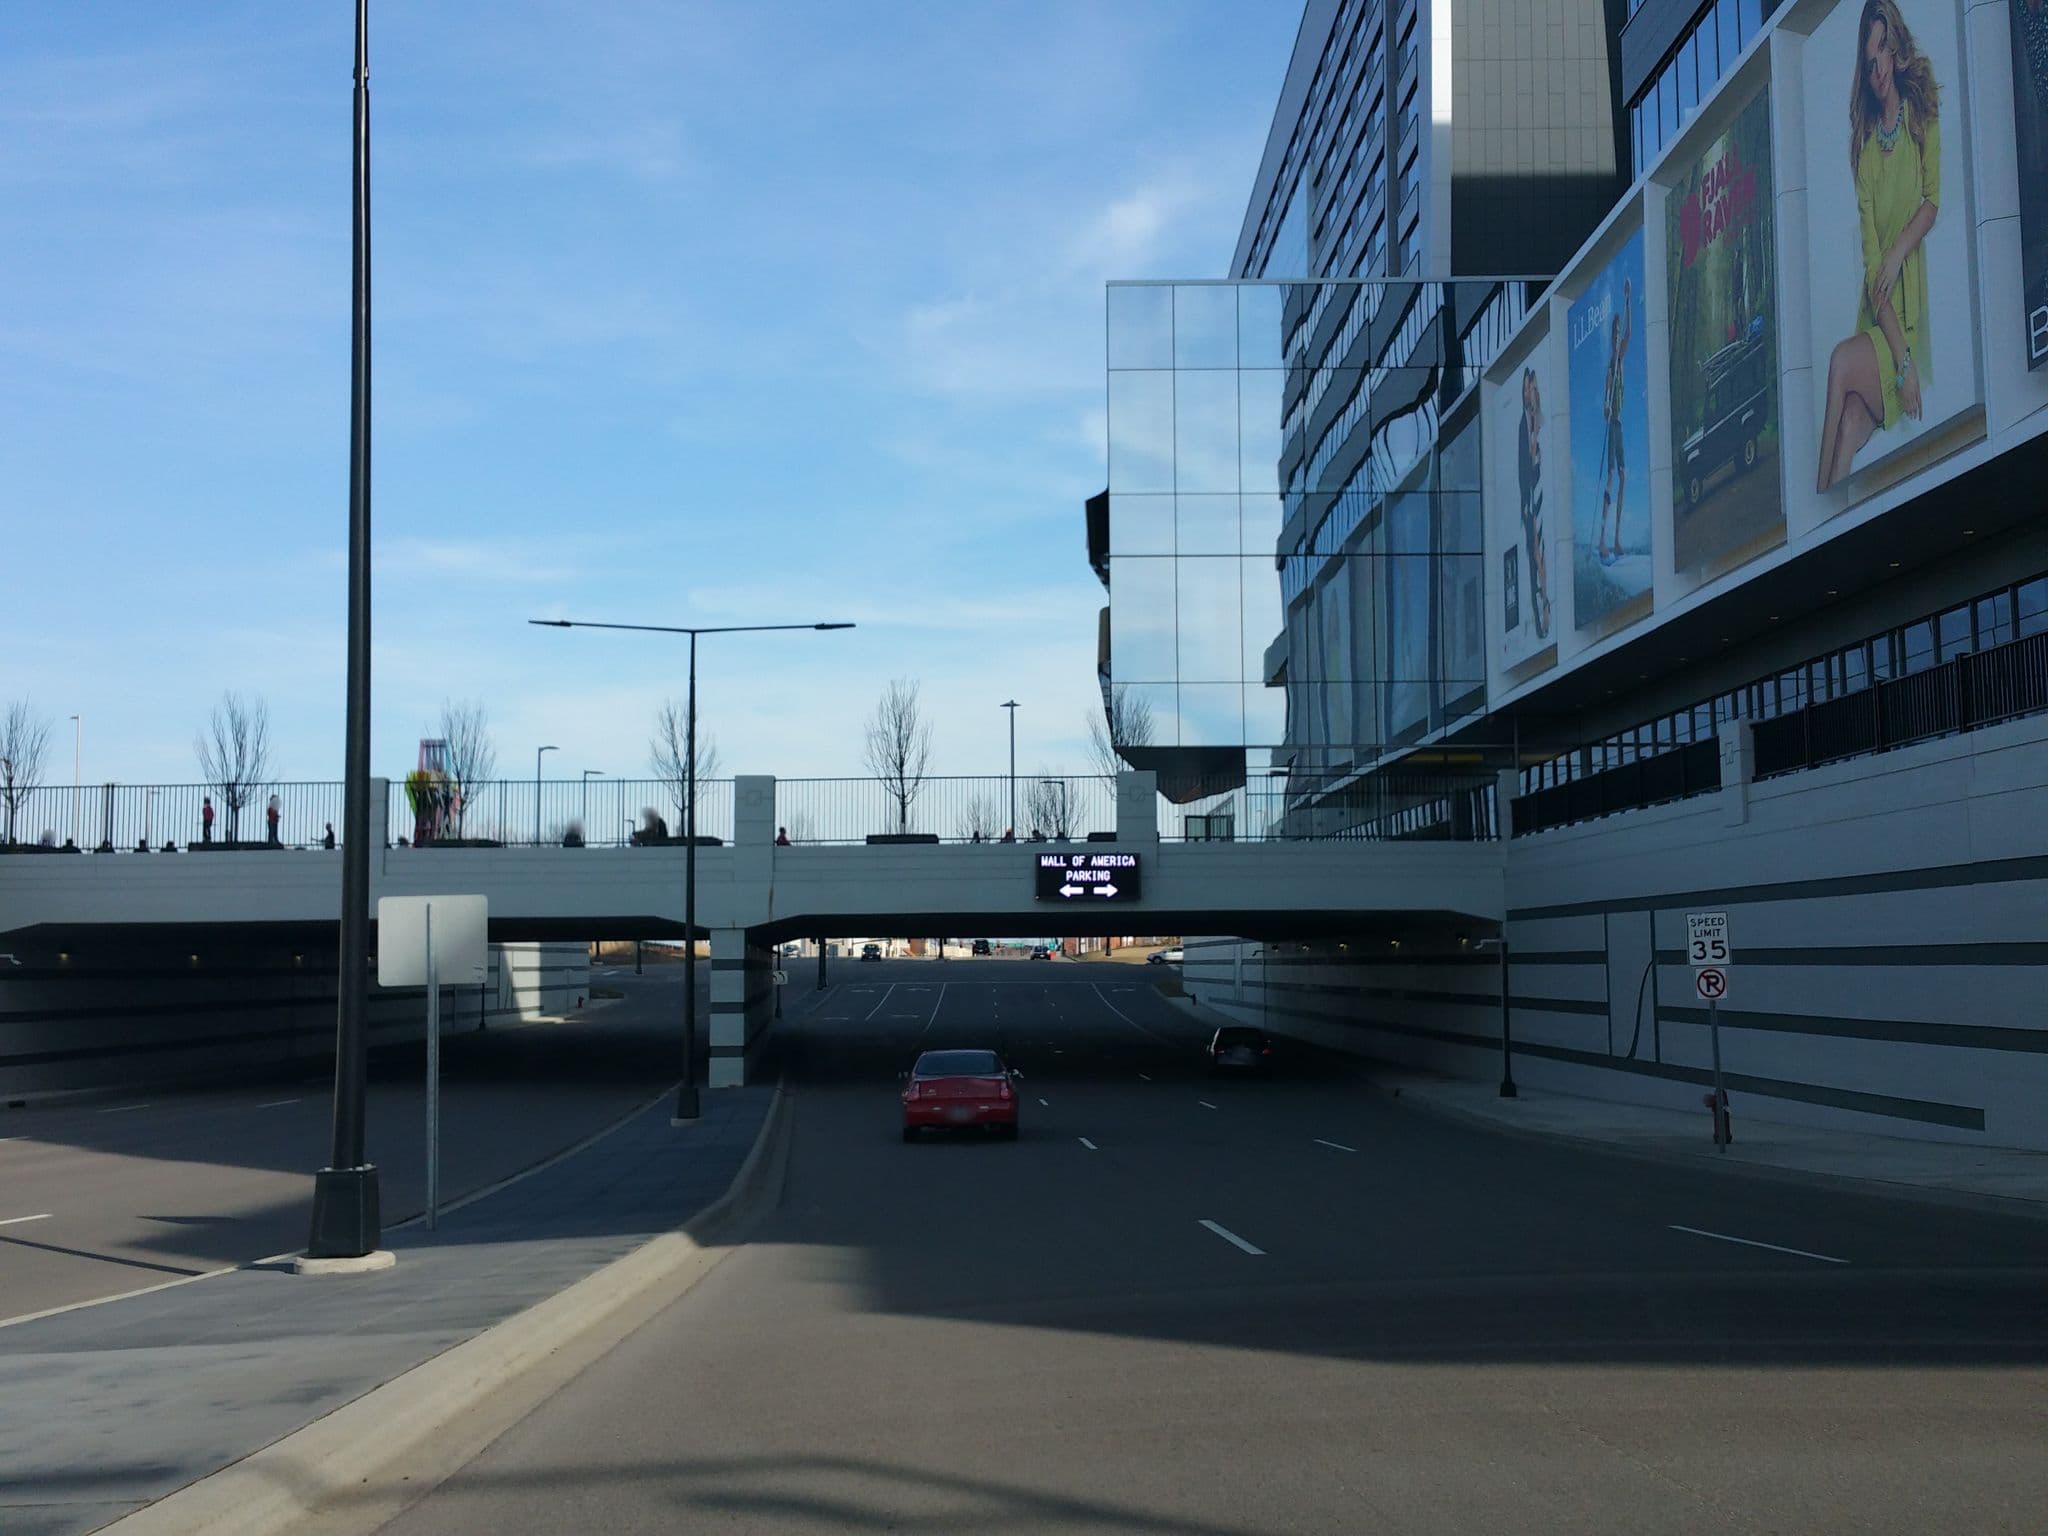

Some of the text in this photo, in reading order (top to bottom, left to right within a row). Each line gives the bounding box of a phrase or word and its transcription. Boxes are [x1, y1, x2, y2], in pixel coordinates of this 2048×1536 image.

[1072, 855, 1086, 867] OF
[1091, 855, 1136, 867] AMERICA
[1065, 870, 1111, 882] PARKING
[1690, 917, 1725, 928] SPEED
[1694, 928, 1721, 938] LIMIT
[1692, 940, 1727, 960] 35
